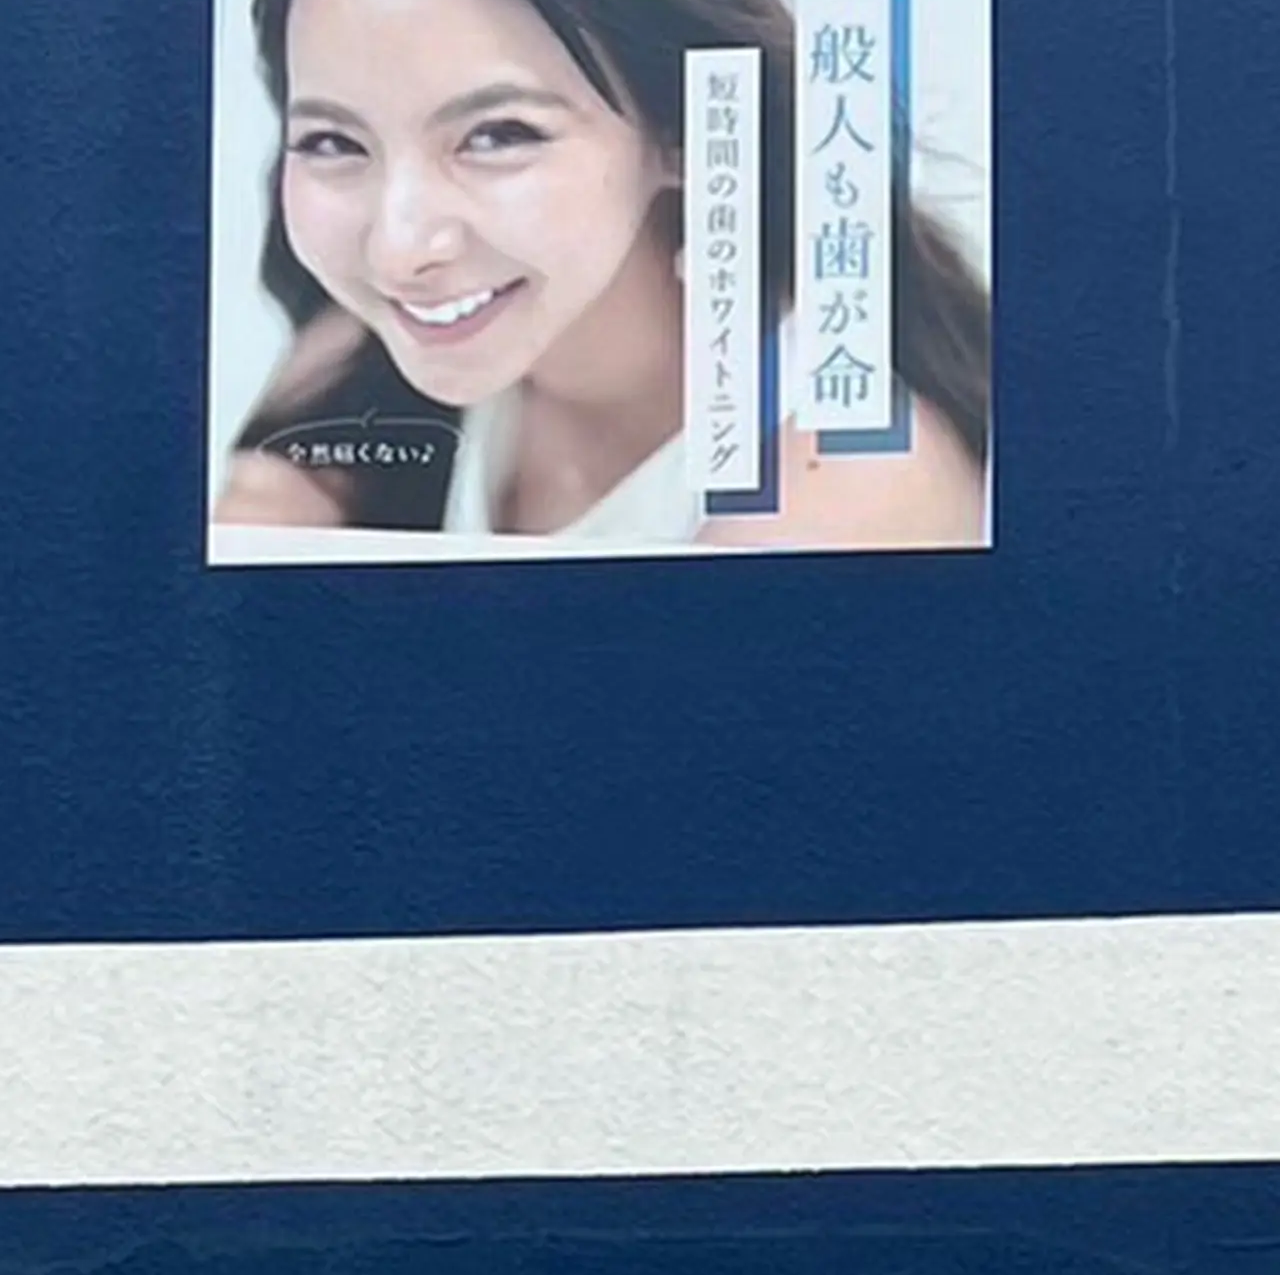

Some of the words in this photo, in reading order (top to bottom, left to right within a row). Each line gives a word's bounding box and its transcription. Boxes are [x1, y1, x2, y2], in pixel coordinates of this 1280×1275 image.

[706, 72, 739, 473] 短時間の歯のホワイトニング
